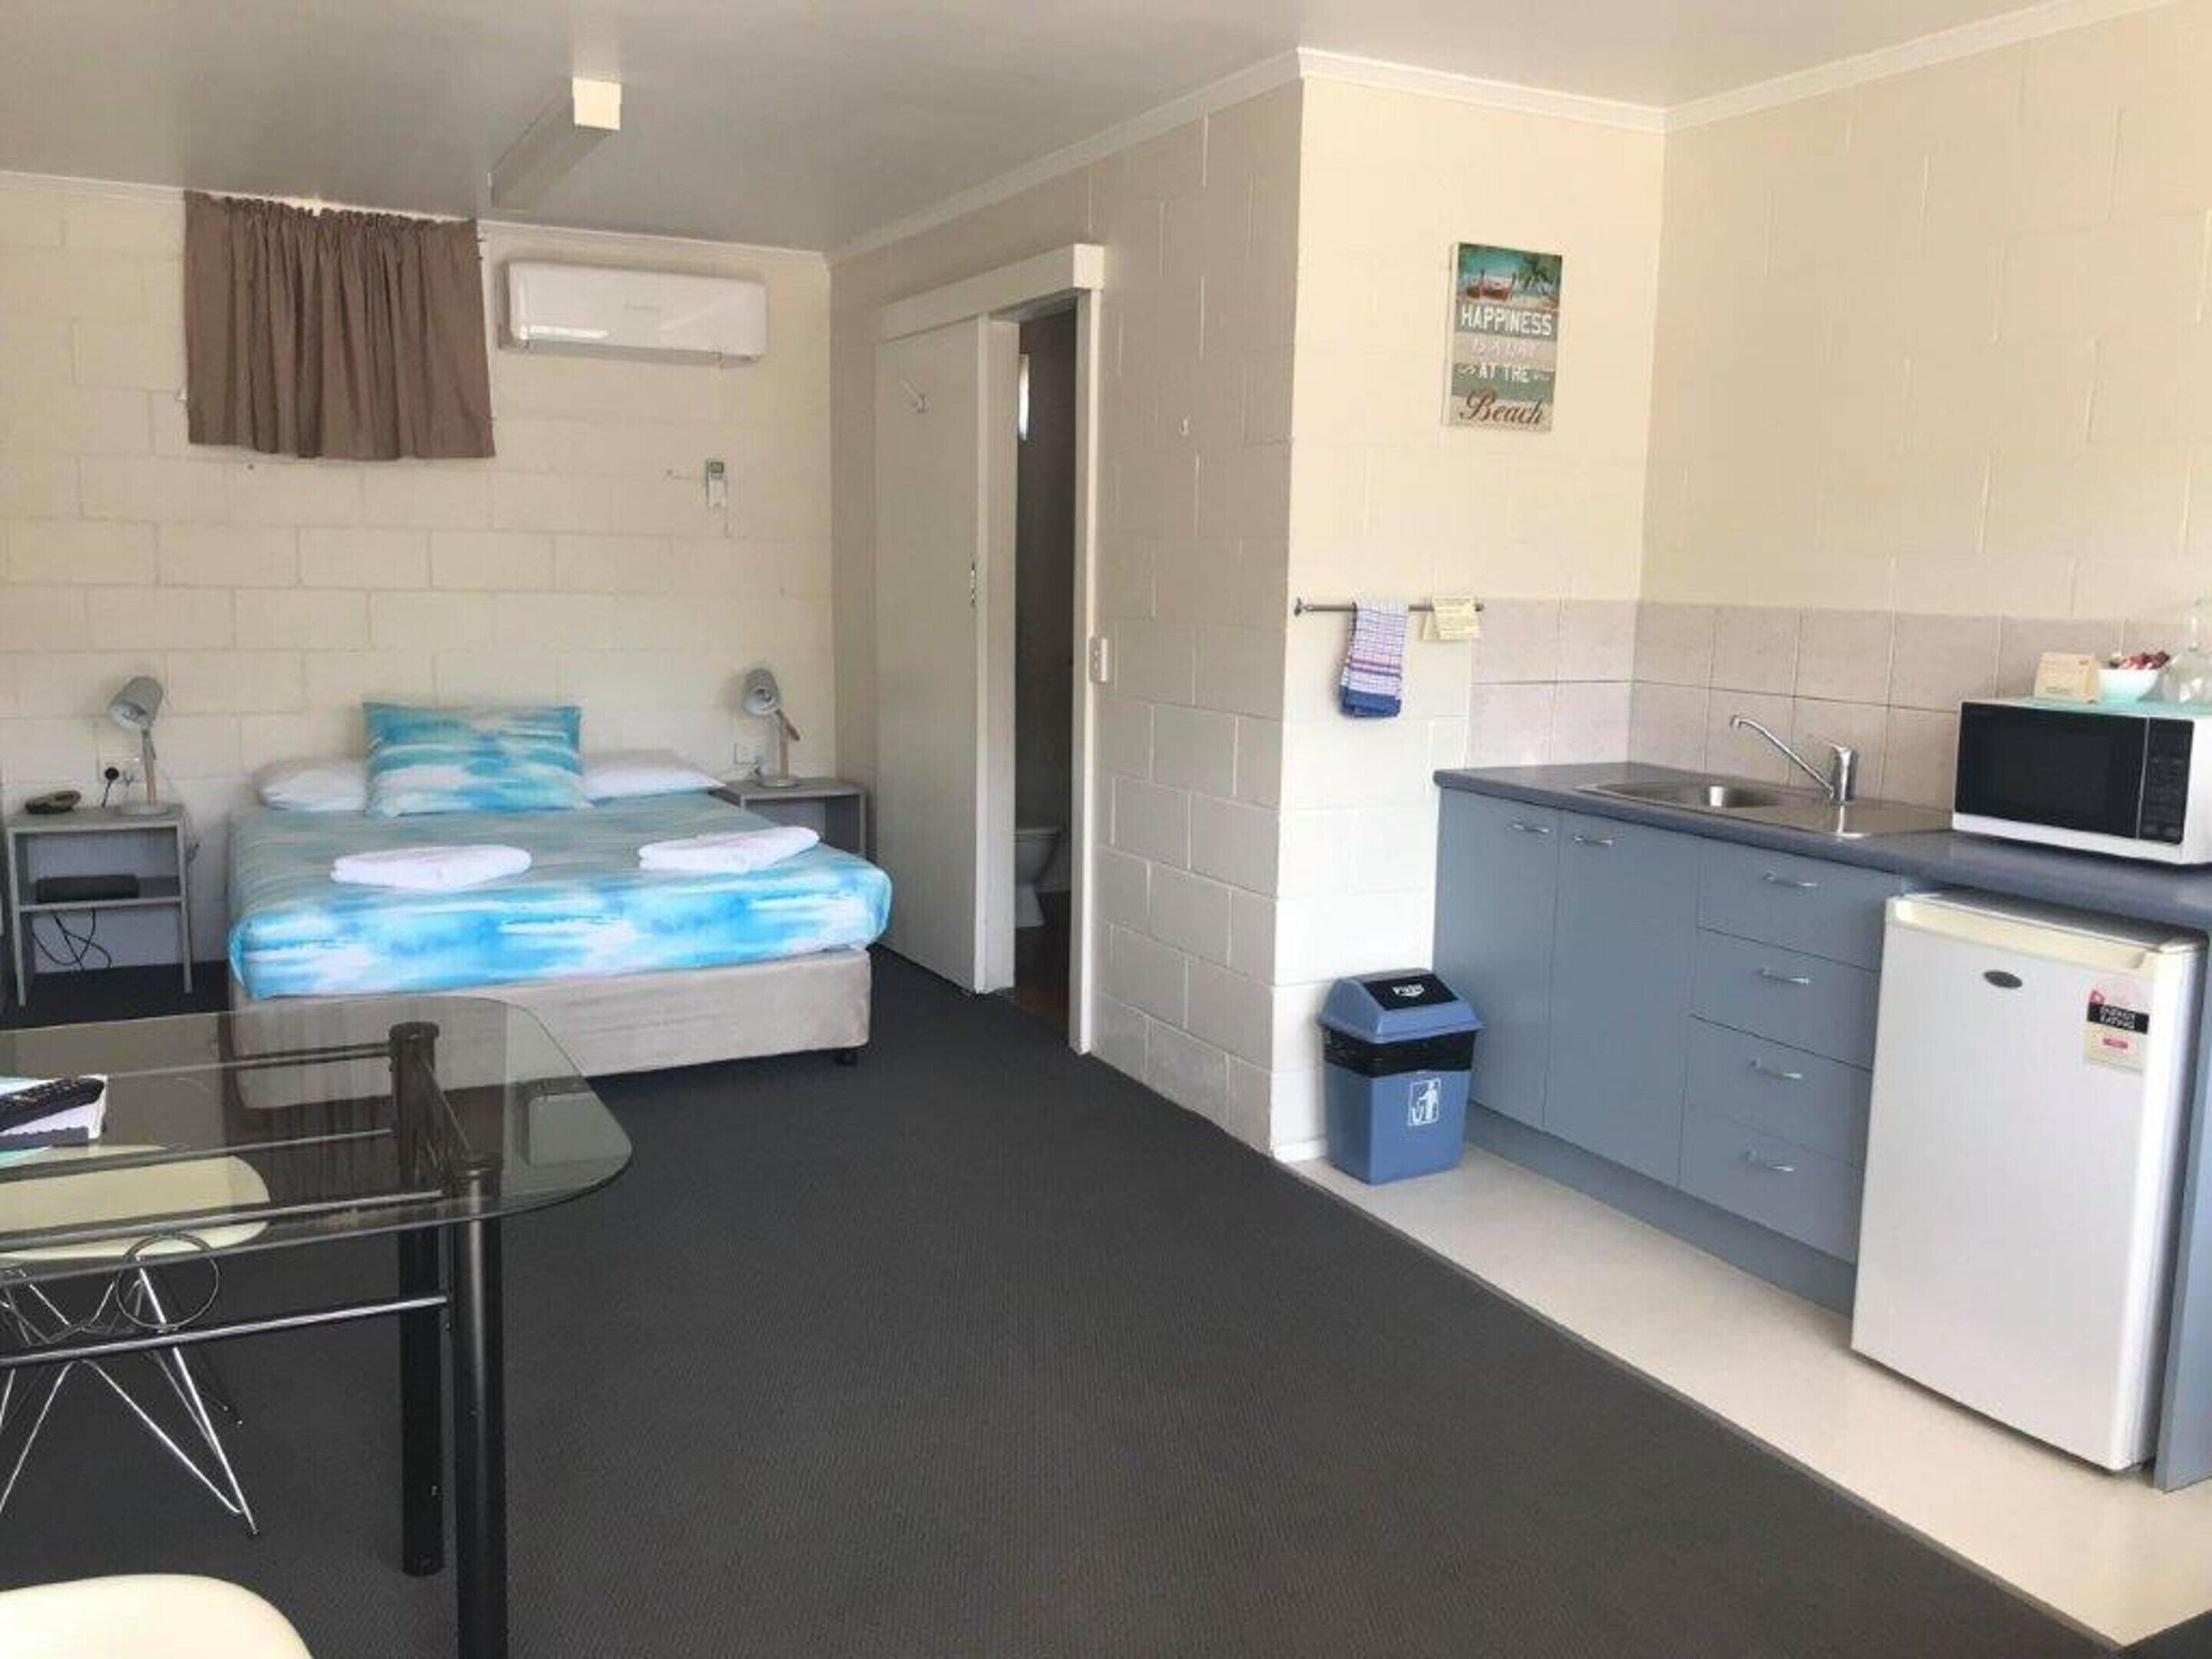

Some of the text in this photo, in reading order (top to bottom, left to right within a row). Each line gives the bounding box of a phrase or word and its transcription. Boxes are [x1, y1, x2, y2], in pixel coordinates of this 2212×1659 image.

[1461, 304, 1551, 336] HAPPINESS
[1479, 362, 1531, 382] AT THE
[1460, 388, 1544, 425] Beach
